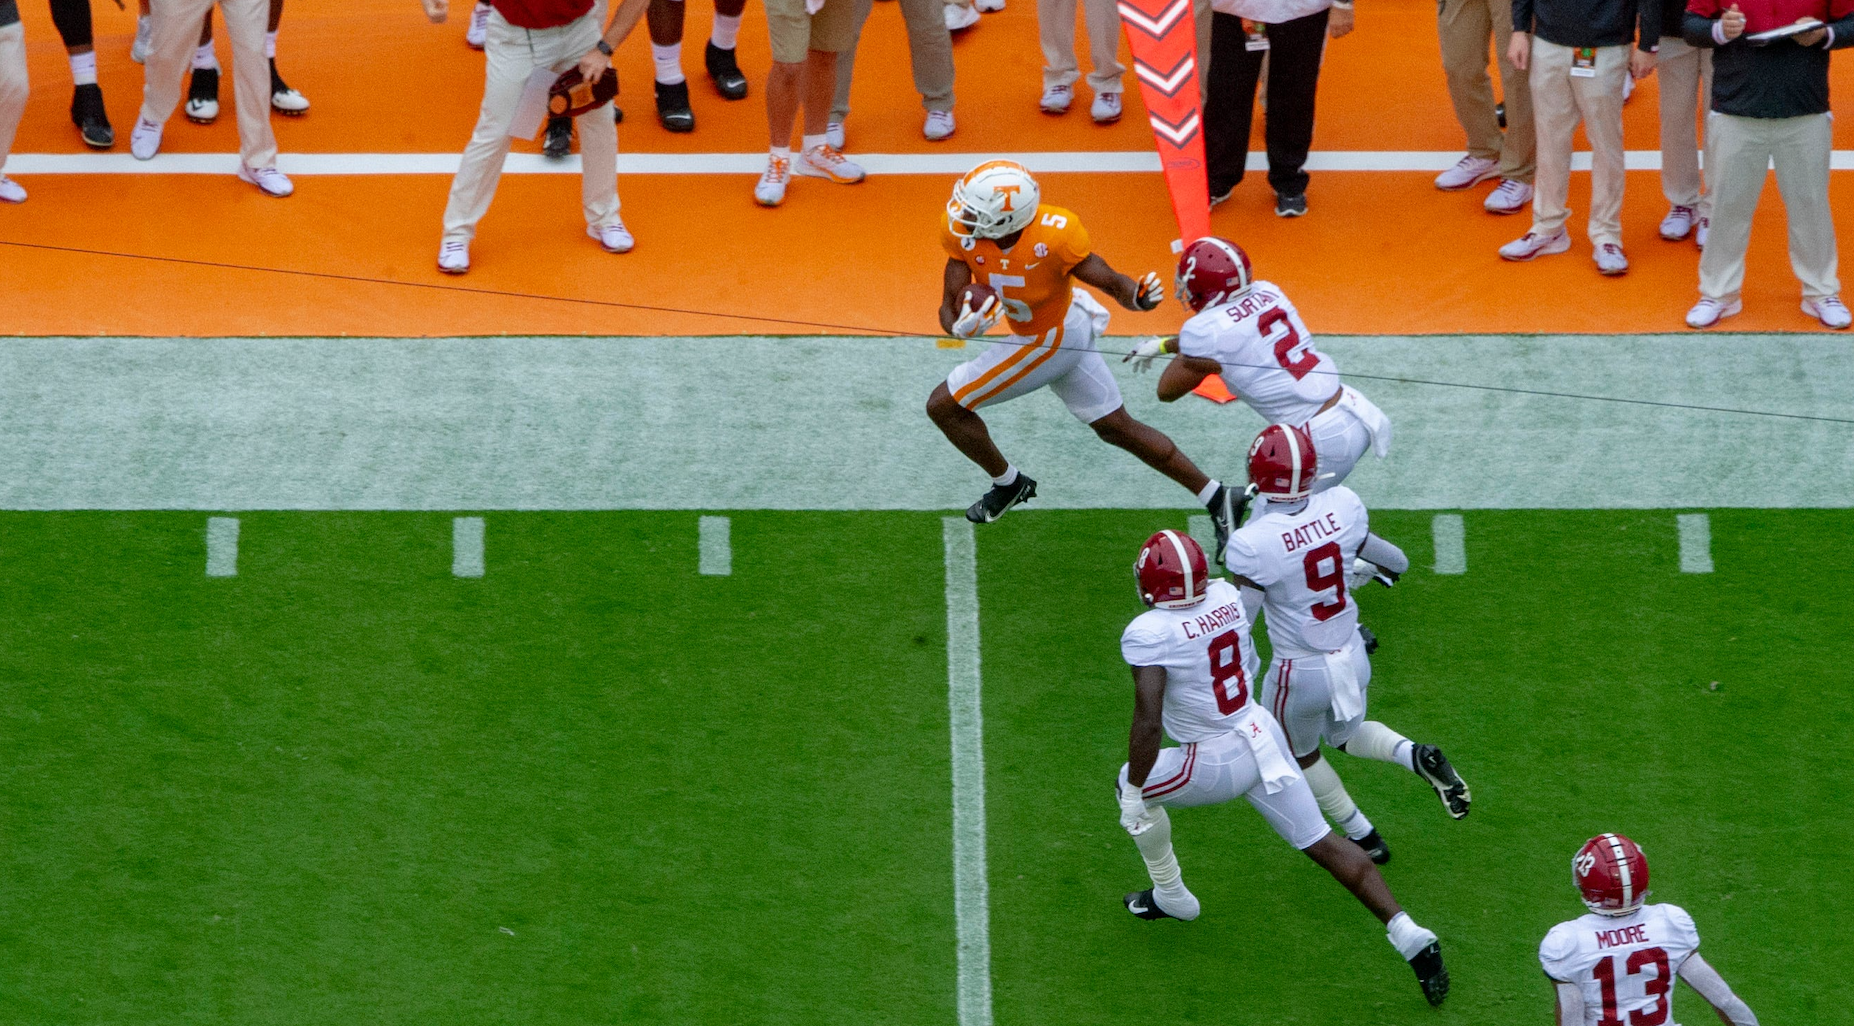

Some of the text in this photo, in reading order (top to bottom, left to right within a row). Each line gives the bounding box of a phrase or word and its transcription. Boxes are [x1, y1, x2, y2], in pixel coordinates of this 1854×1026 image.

[994, 185, 1020, 212] T
[1041, 213, 1068, 229] 5
[1000, 259, 1010, 270] T
[1182, 256, 1196, 281] 2
[989, 273, 1033, 322] 5
[1226, 290, 1280, 323] SURTAI
[1258, 305, 1321, 381] 2
[1250, 435, 1264, 457] 9
[1281, 512, 1341, 552] BATTLE
[1138, 547, 1150, 569] 8
[1303, 541, 1346, 621] 9
[1207, 629, 1248, 716] 8
[1595, 923, 1649, 949] MOORE
[1593, 947, 1671, 1026] 13
